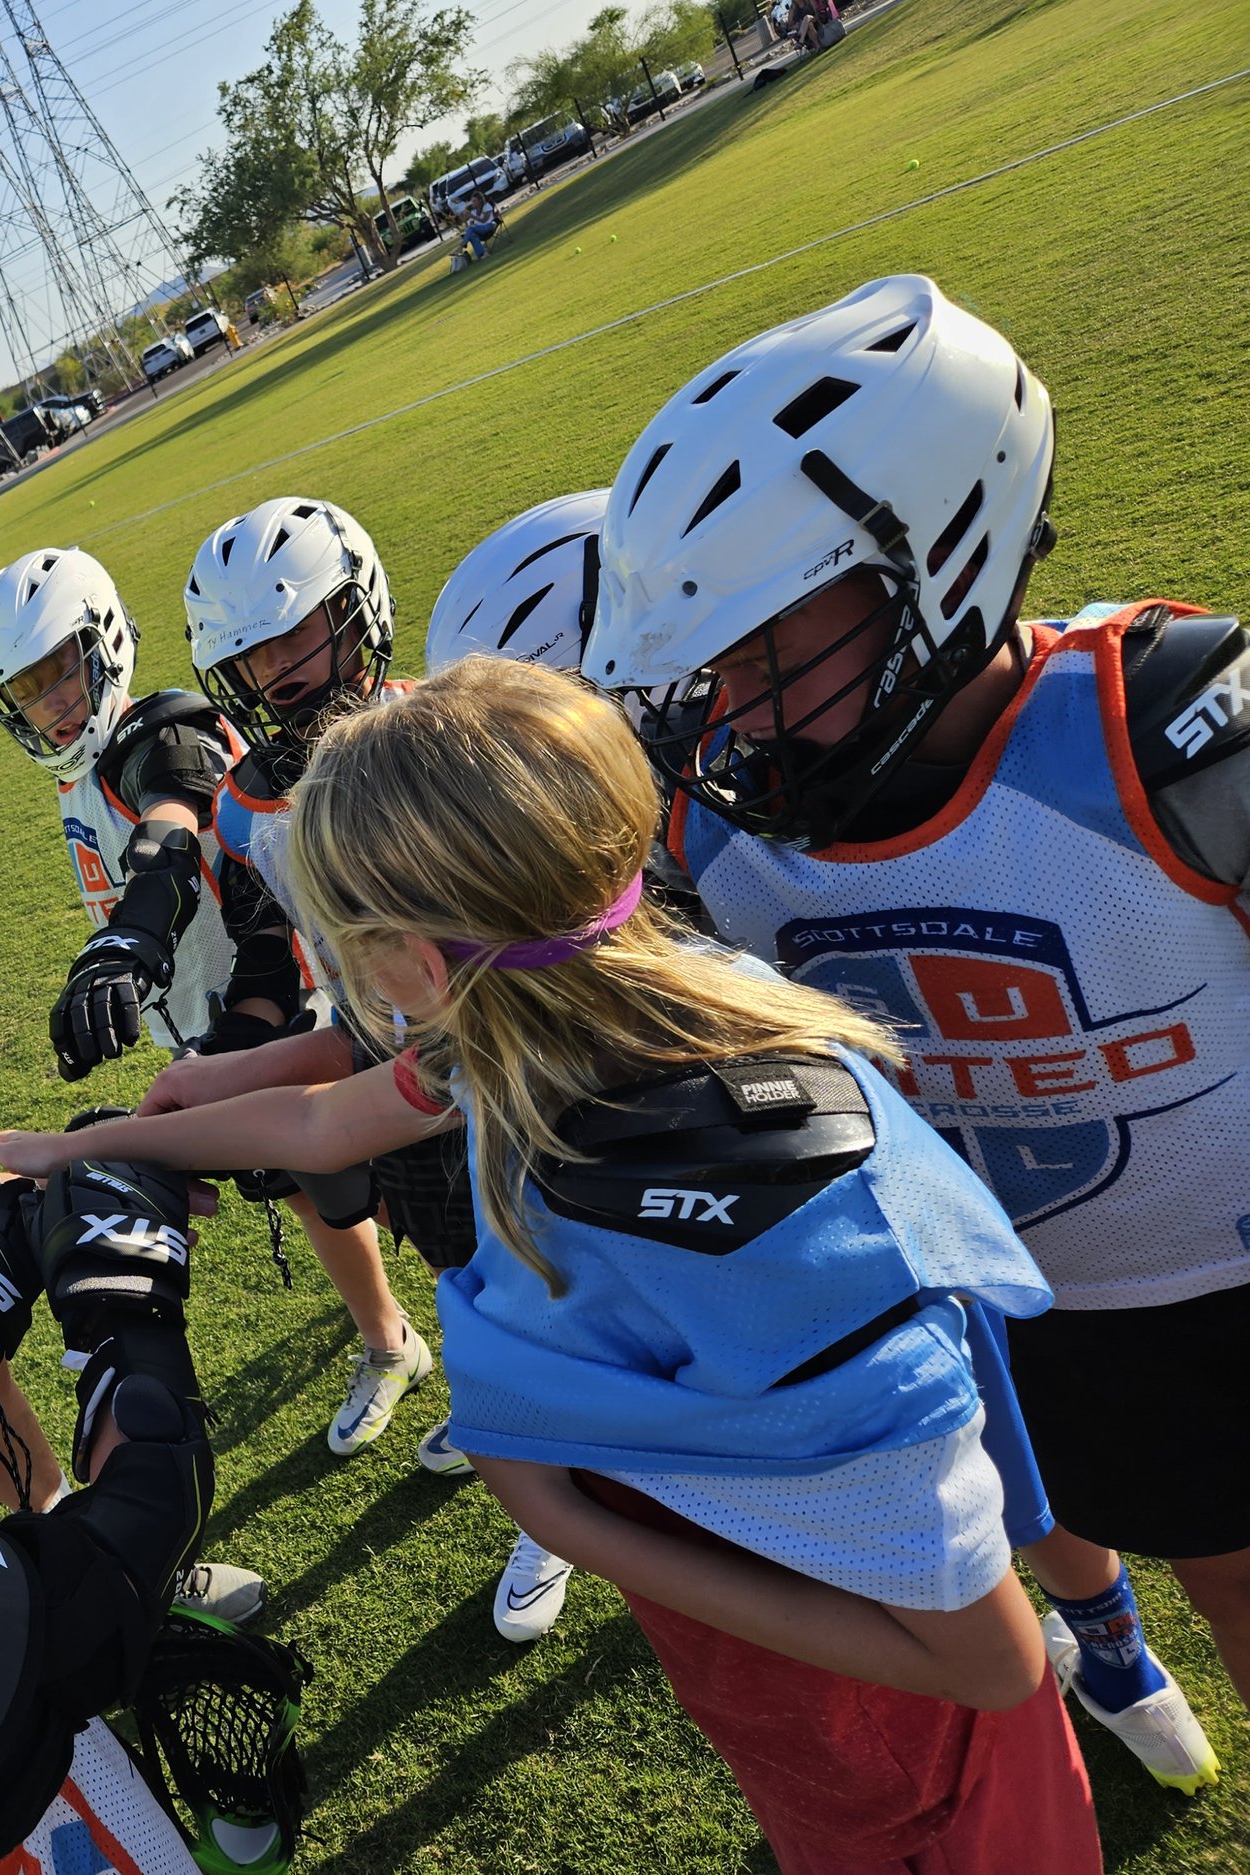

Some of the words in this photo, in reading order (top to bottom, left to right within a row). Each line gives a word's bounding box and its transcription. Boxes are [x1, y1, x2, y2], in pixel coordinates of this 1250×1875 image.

[116, 717, 145, 745] STX
[871, 699, 934, 775] cascade
[83, 862, 100, 882] U
[792, 921, 1043, 948] SCOTTSDALE
[955, 986, 1029, 1022] U
[897, 1022, 1197, 1099] ITED
[741, 1080, 796, 1095] PINNIE
[745, 1090, 801, 1103] HOLDER
[911, 1100, 1082, 1118] CROSSE
[1016, 1145, 1073, 1170] L
[637, 1188, 740, 1225] STX
[76, 1213, 188, 1266] STX
